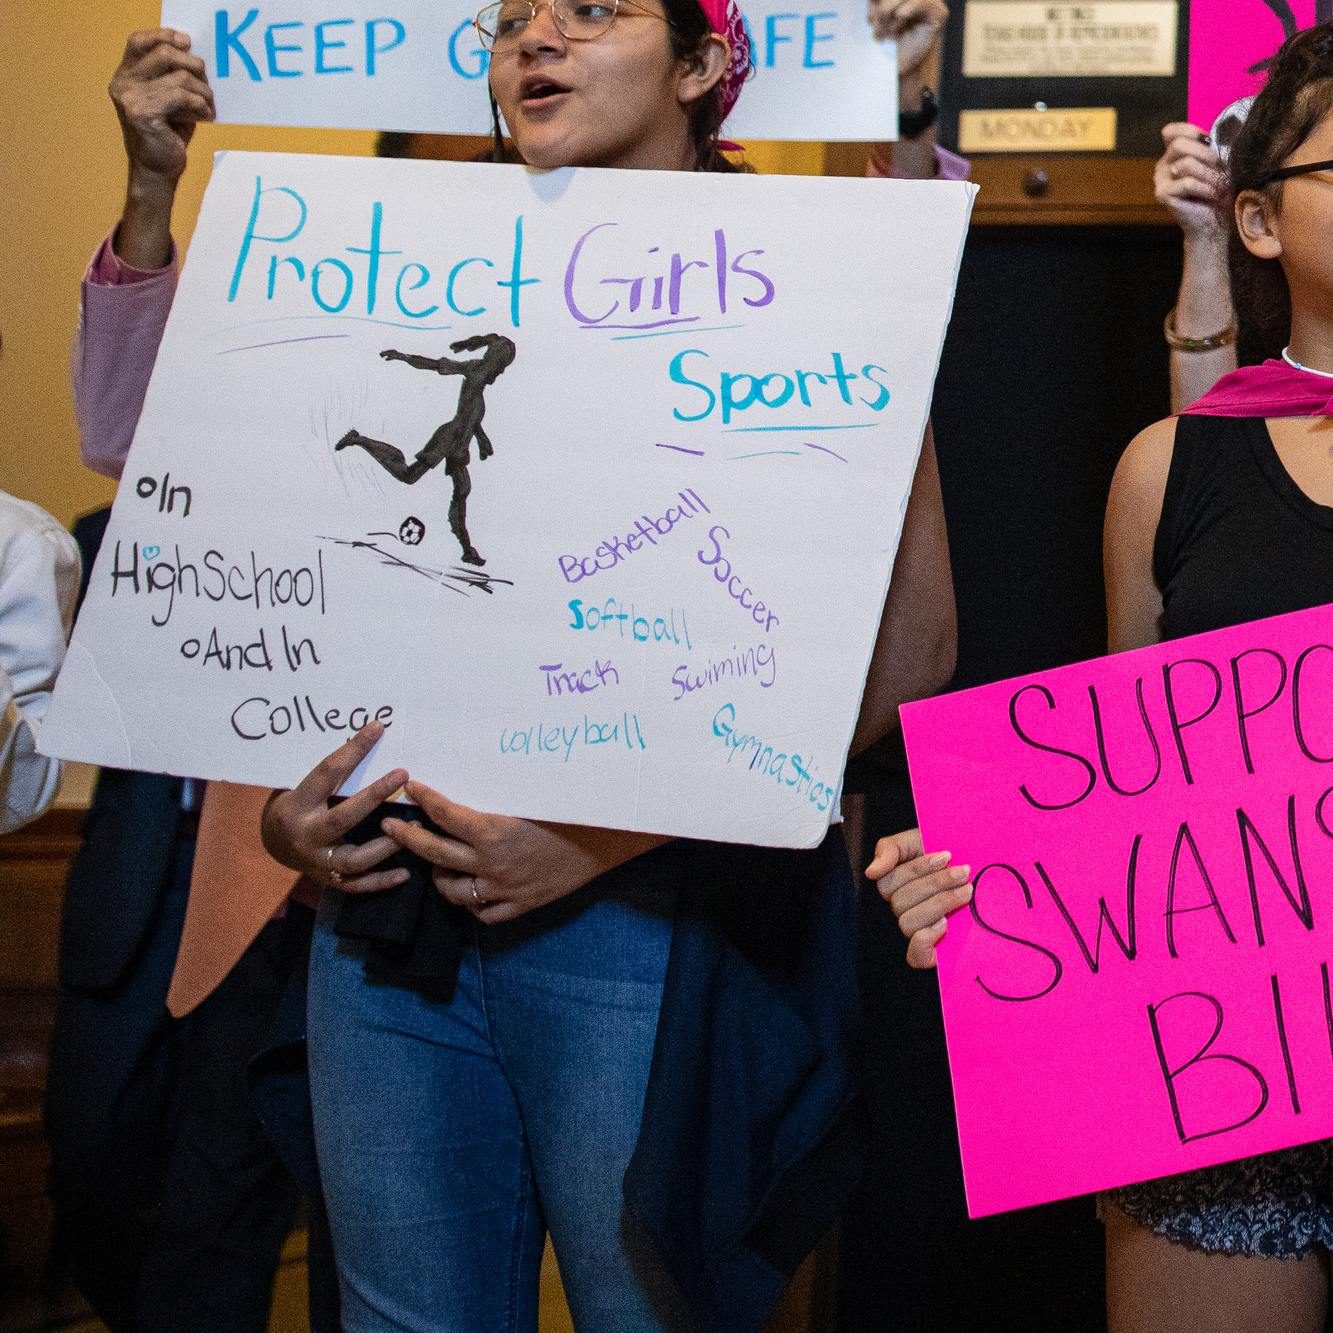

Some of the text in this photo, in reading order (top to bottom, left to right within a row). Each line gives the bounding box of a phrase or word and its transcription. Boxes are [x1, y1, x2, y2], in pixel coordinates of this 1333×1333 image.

[213, 7, 408, 83] KEEP
[227, 174, 776, 328] Protect Girls
[667, 348, 892, 425] Sports
[557, 487, 712, 584] Basketball
[697, 525, 780, 633] Soccer
[203, 624, 321, 672] And In
[538, 659, 620, 697] Track
[712, 702, 835, 812] Gymnastics
